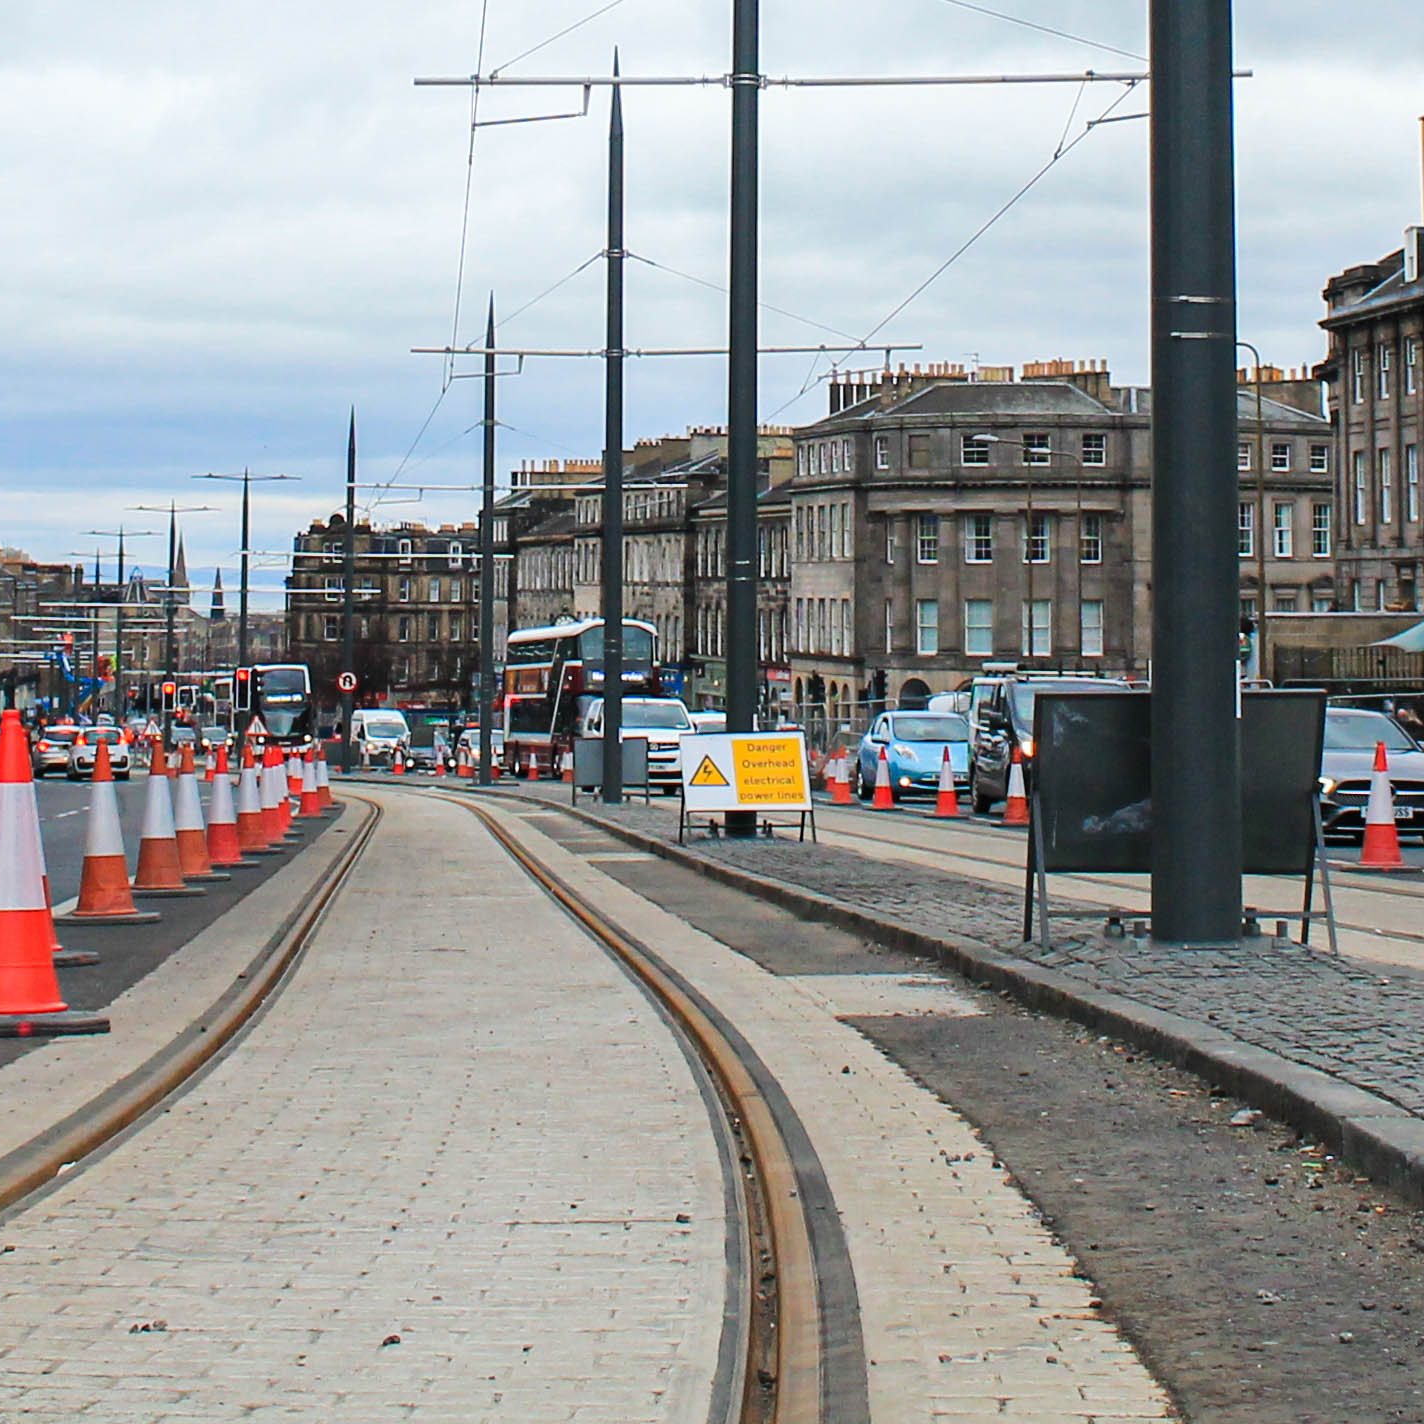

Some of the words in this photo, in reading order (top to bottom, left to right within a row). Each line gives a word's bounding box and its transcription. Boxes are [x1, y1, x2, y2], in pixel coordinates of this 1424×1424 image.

[747, 743, 786, 753] Danger
[742, 759, 795, 769] Overhead
[744, 776, 795, 785] electrical
[739, 792, 774, 801] power
[777, 791, 804, 801] lines
